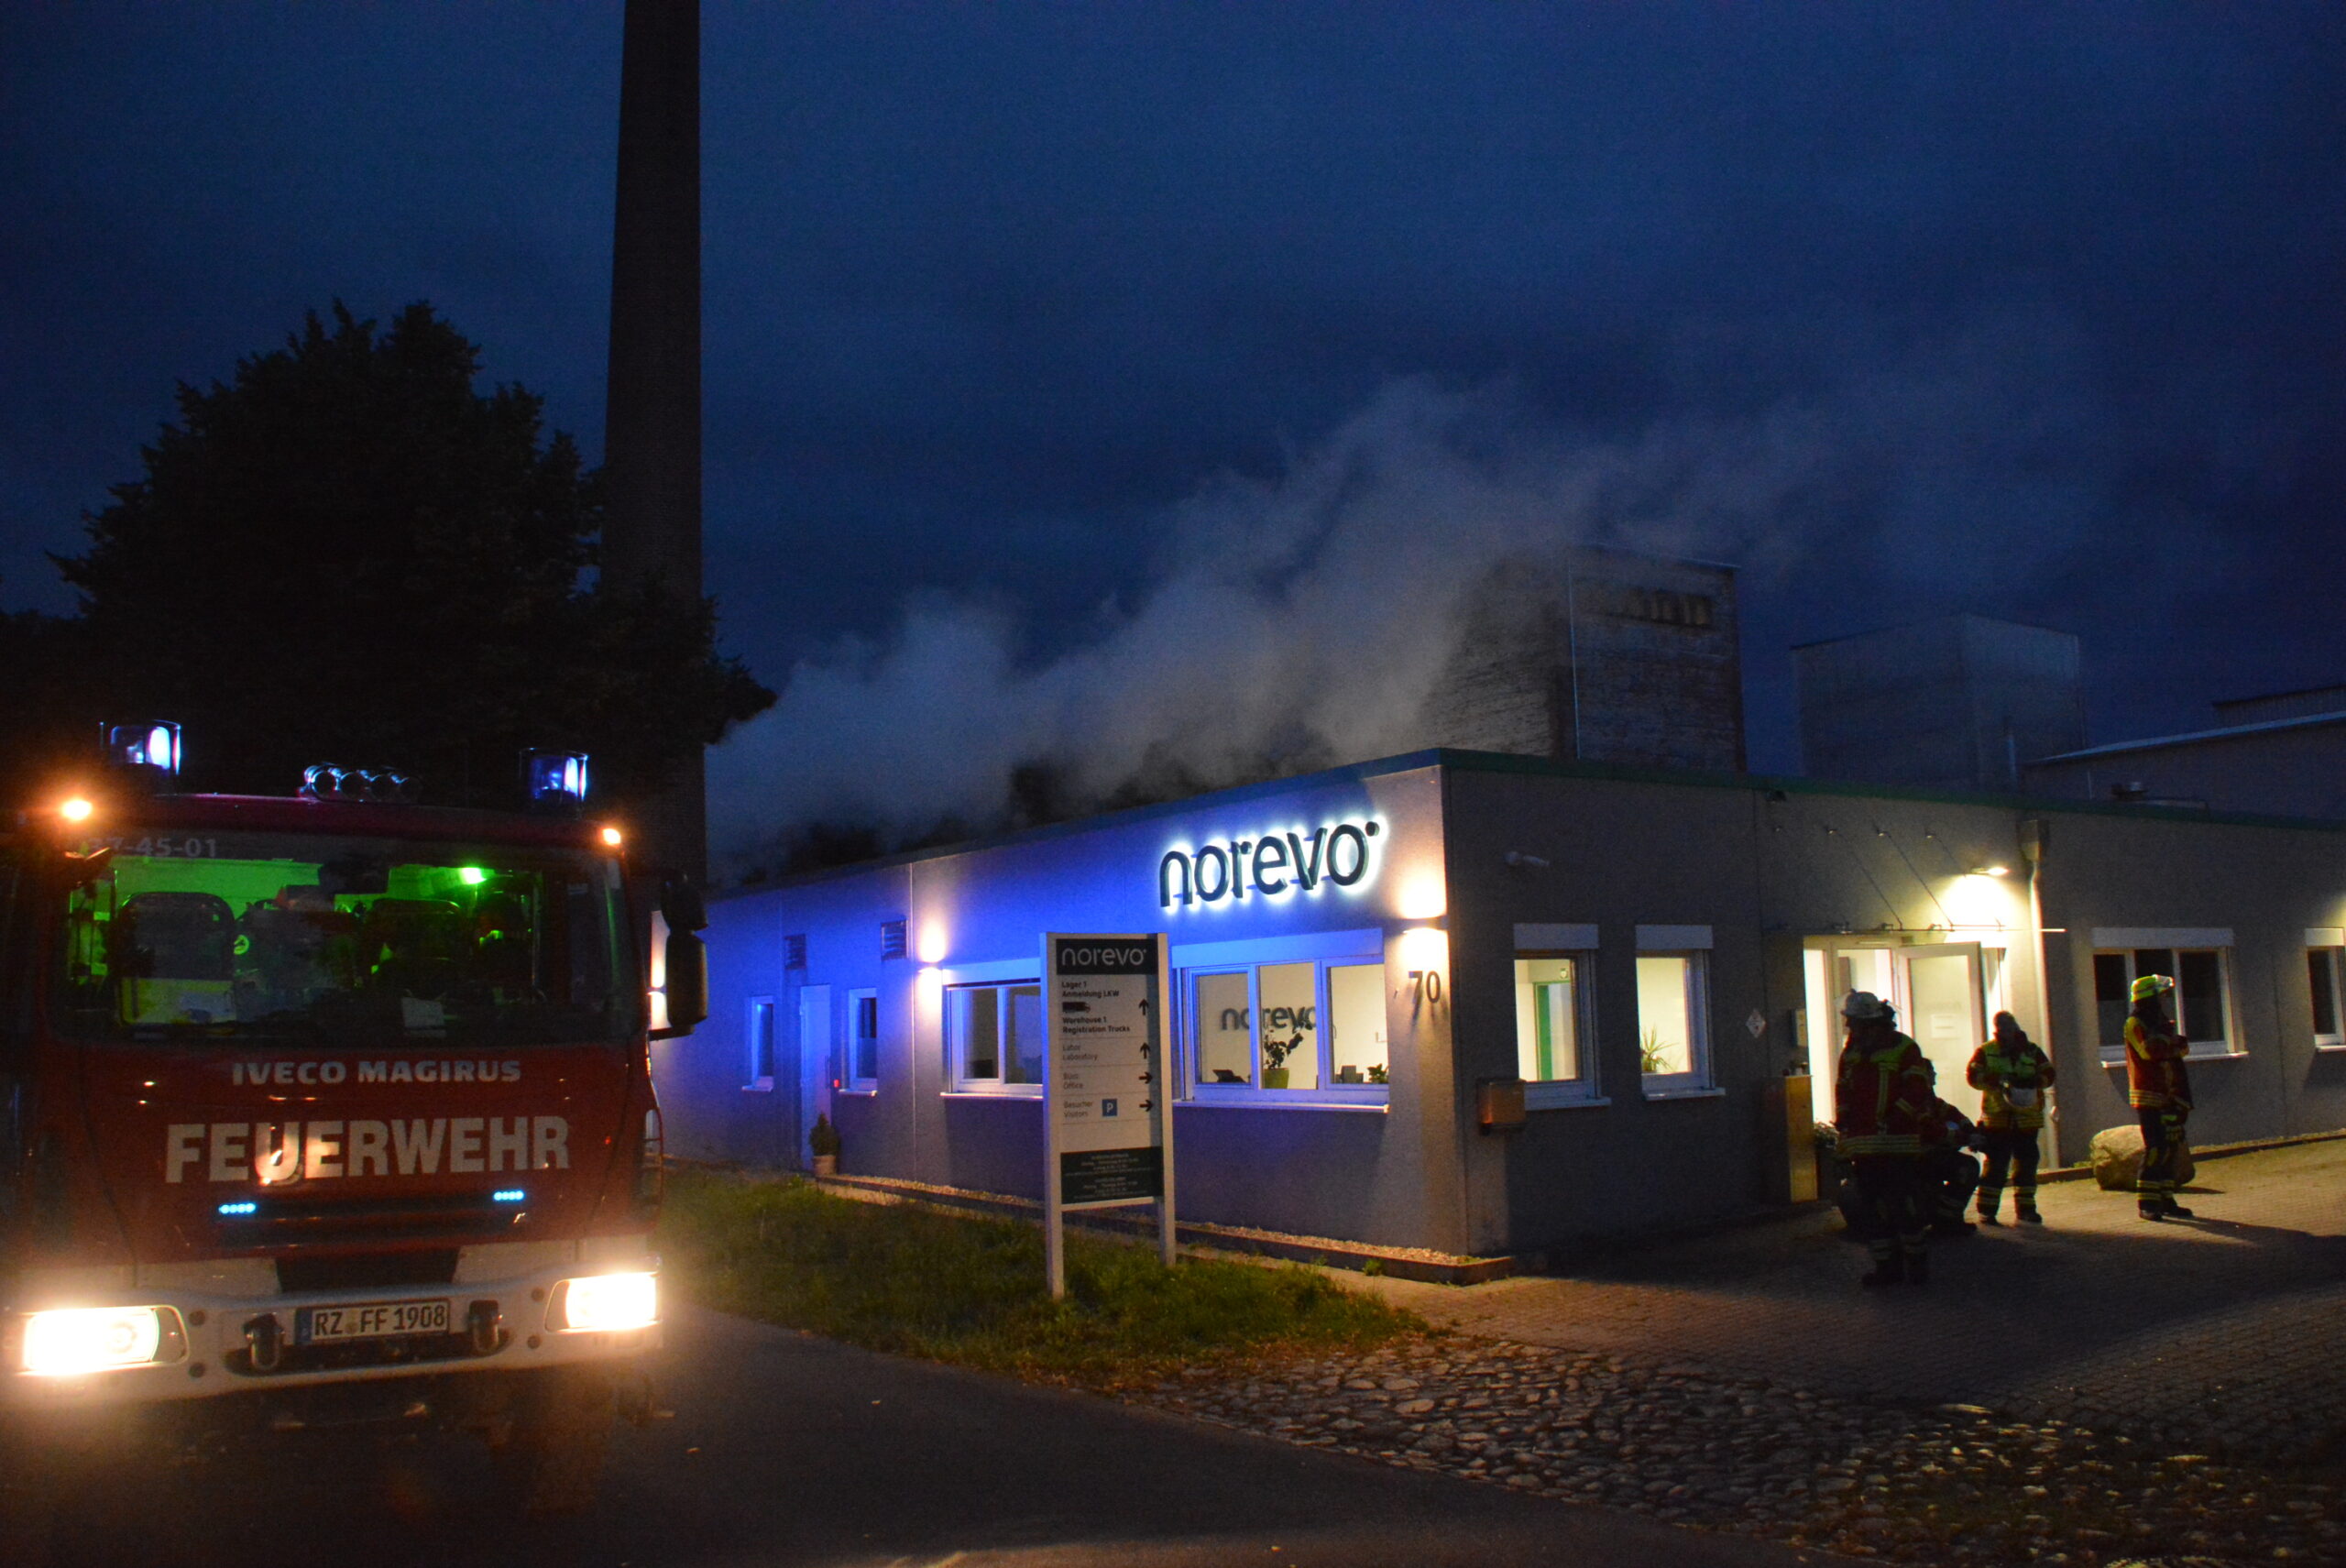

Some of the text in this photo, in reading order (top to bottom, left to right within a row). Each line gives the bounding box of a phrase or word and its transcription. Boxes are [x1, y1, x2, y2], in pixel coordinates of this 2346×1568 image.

[1159, 821, 1380, 907] norevo
[1062, 948, 1147, 966] norevo
[1409, 970, 1442, 1004] 70
[233, 1060, 521, 1086] IVECO MAGIRUS
[165, 1116, 570, 1184] FEUERWEHR
[314, 1312, 344, 1336] RZ
[360, 1309, 388, 1332] FF
[393, 1305, 445, 1330] 1908
